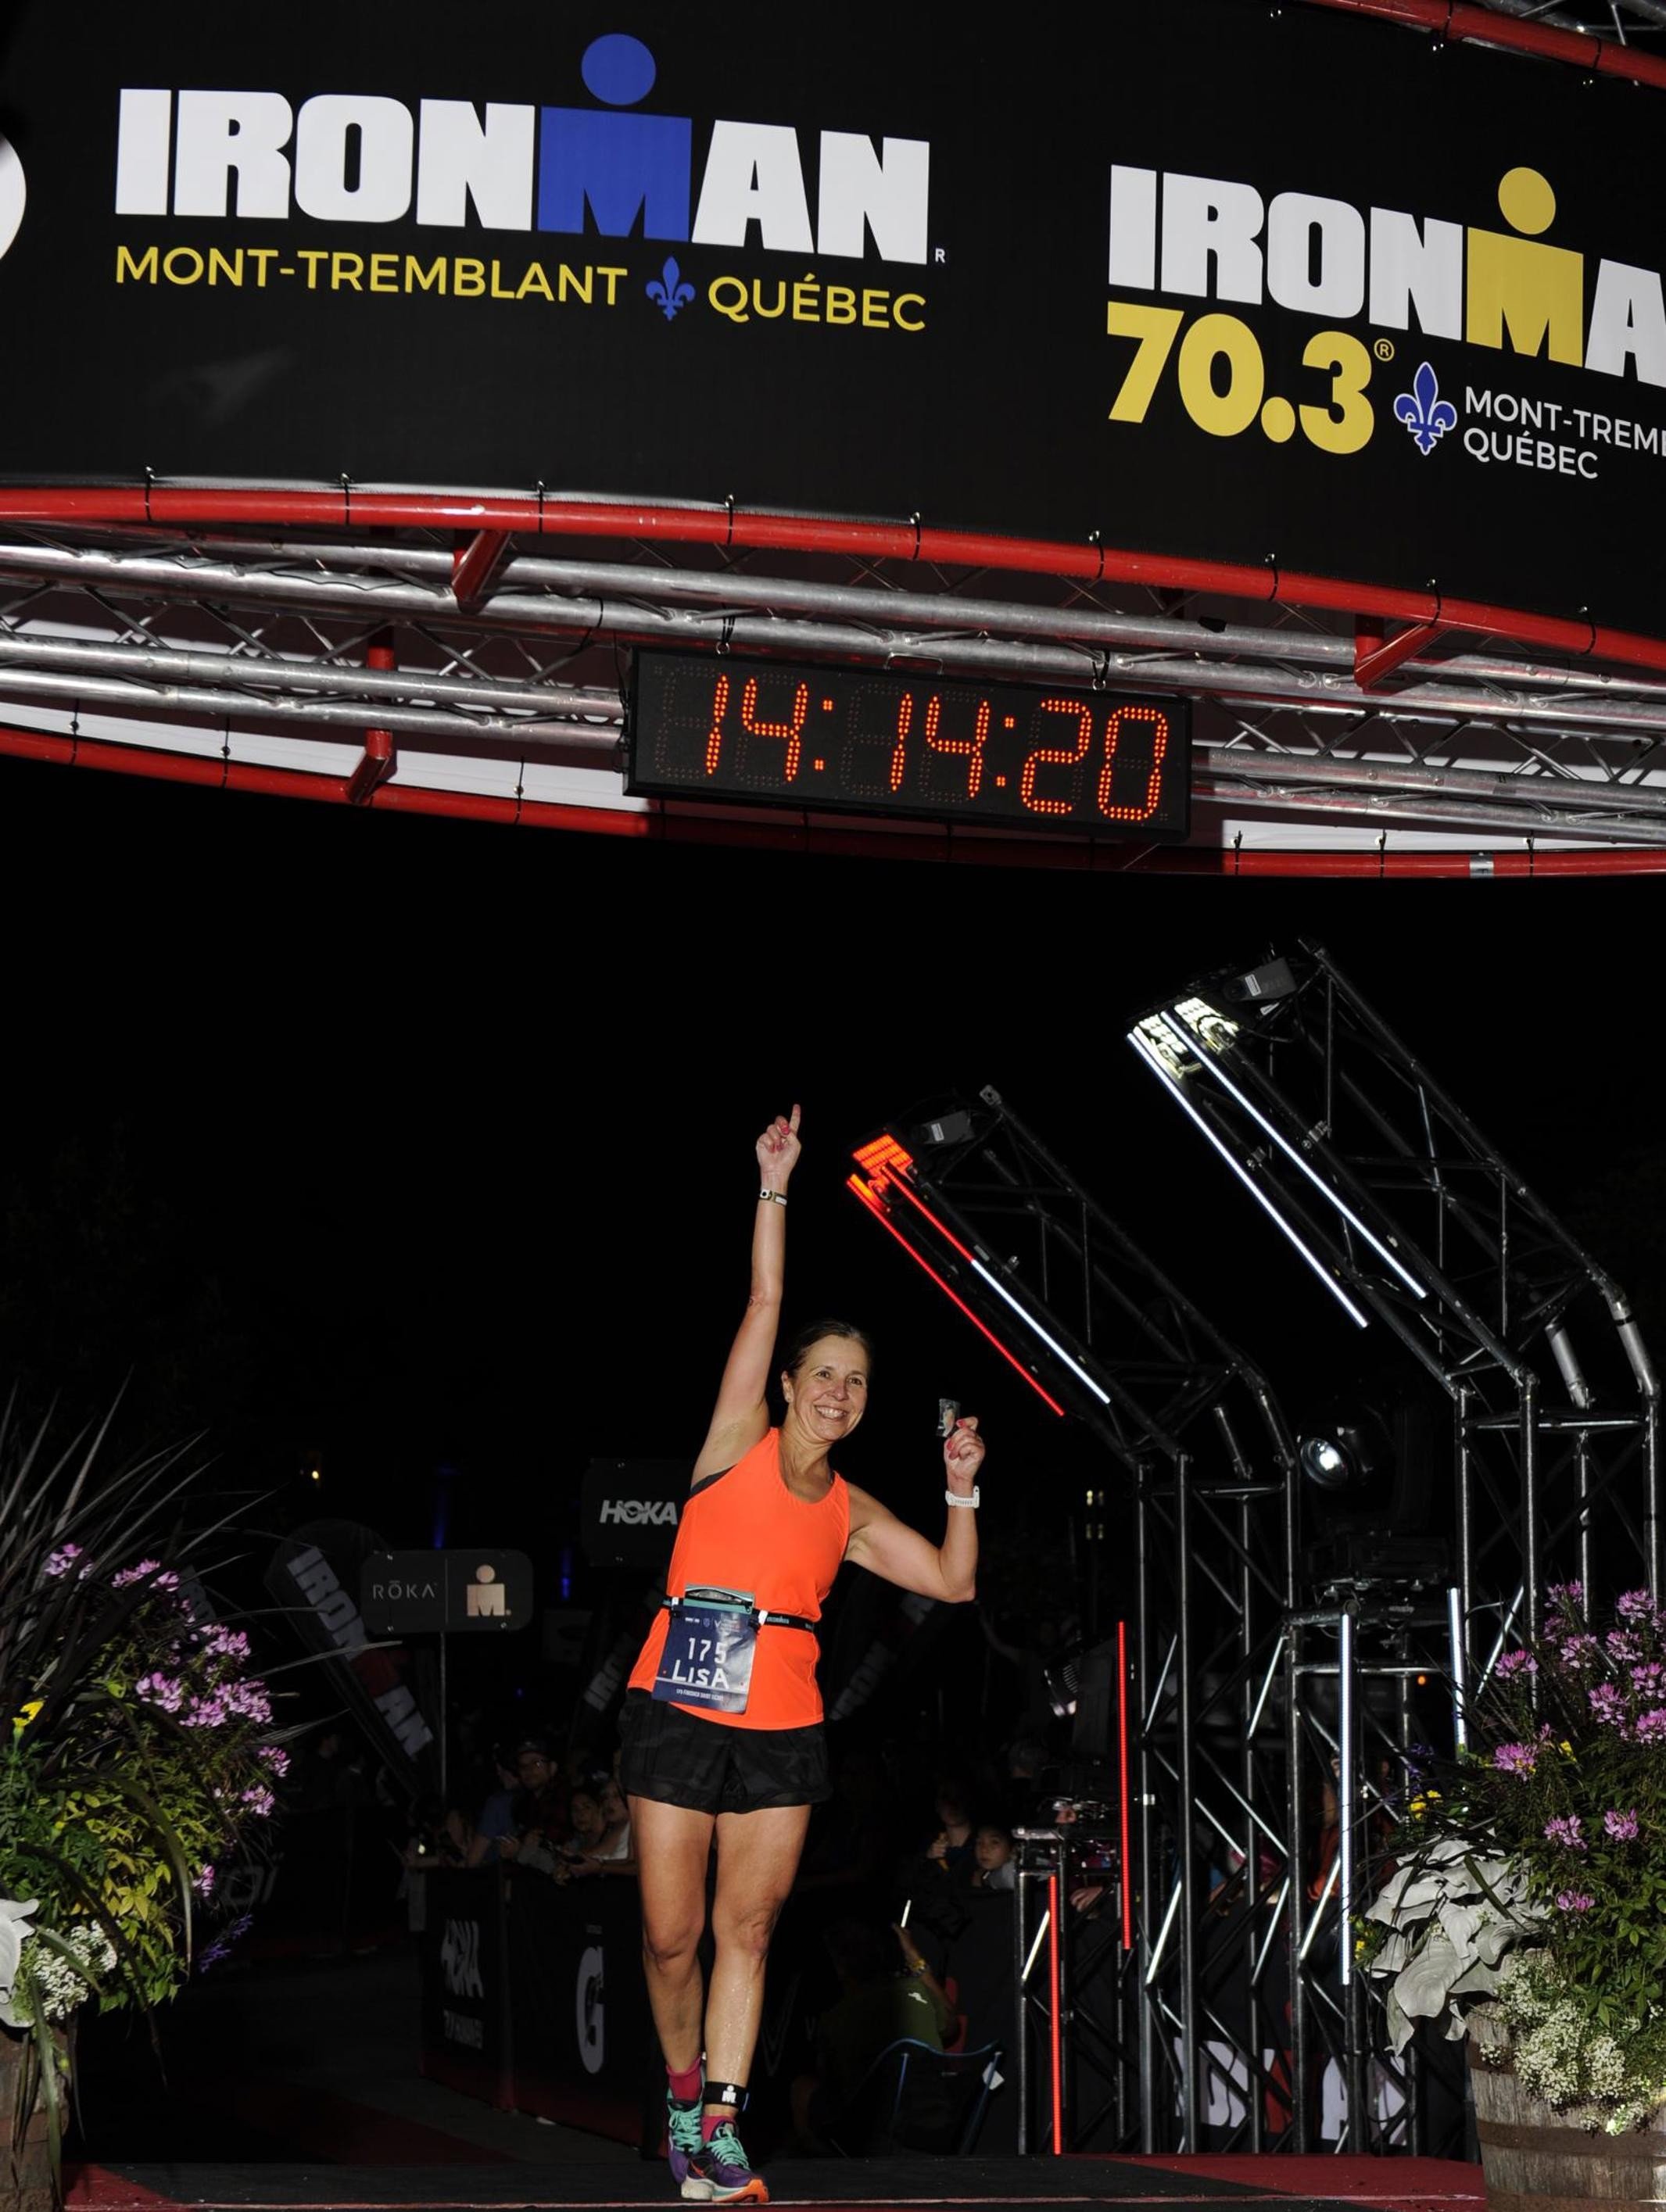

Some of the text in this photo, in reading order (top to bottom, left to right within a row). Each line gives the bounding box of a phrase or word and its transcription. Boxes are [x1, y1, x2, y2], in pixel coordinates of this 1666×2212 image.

[115, 34, 930, 265] IRONMAN
[116, 245, 926, 331] MONT-TREMBLANT QUÉBEC
[1464, 430, 1599, 479] QUÉBEC
[599, 1499, 678, 1526] HOKA
